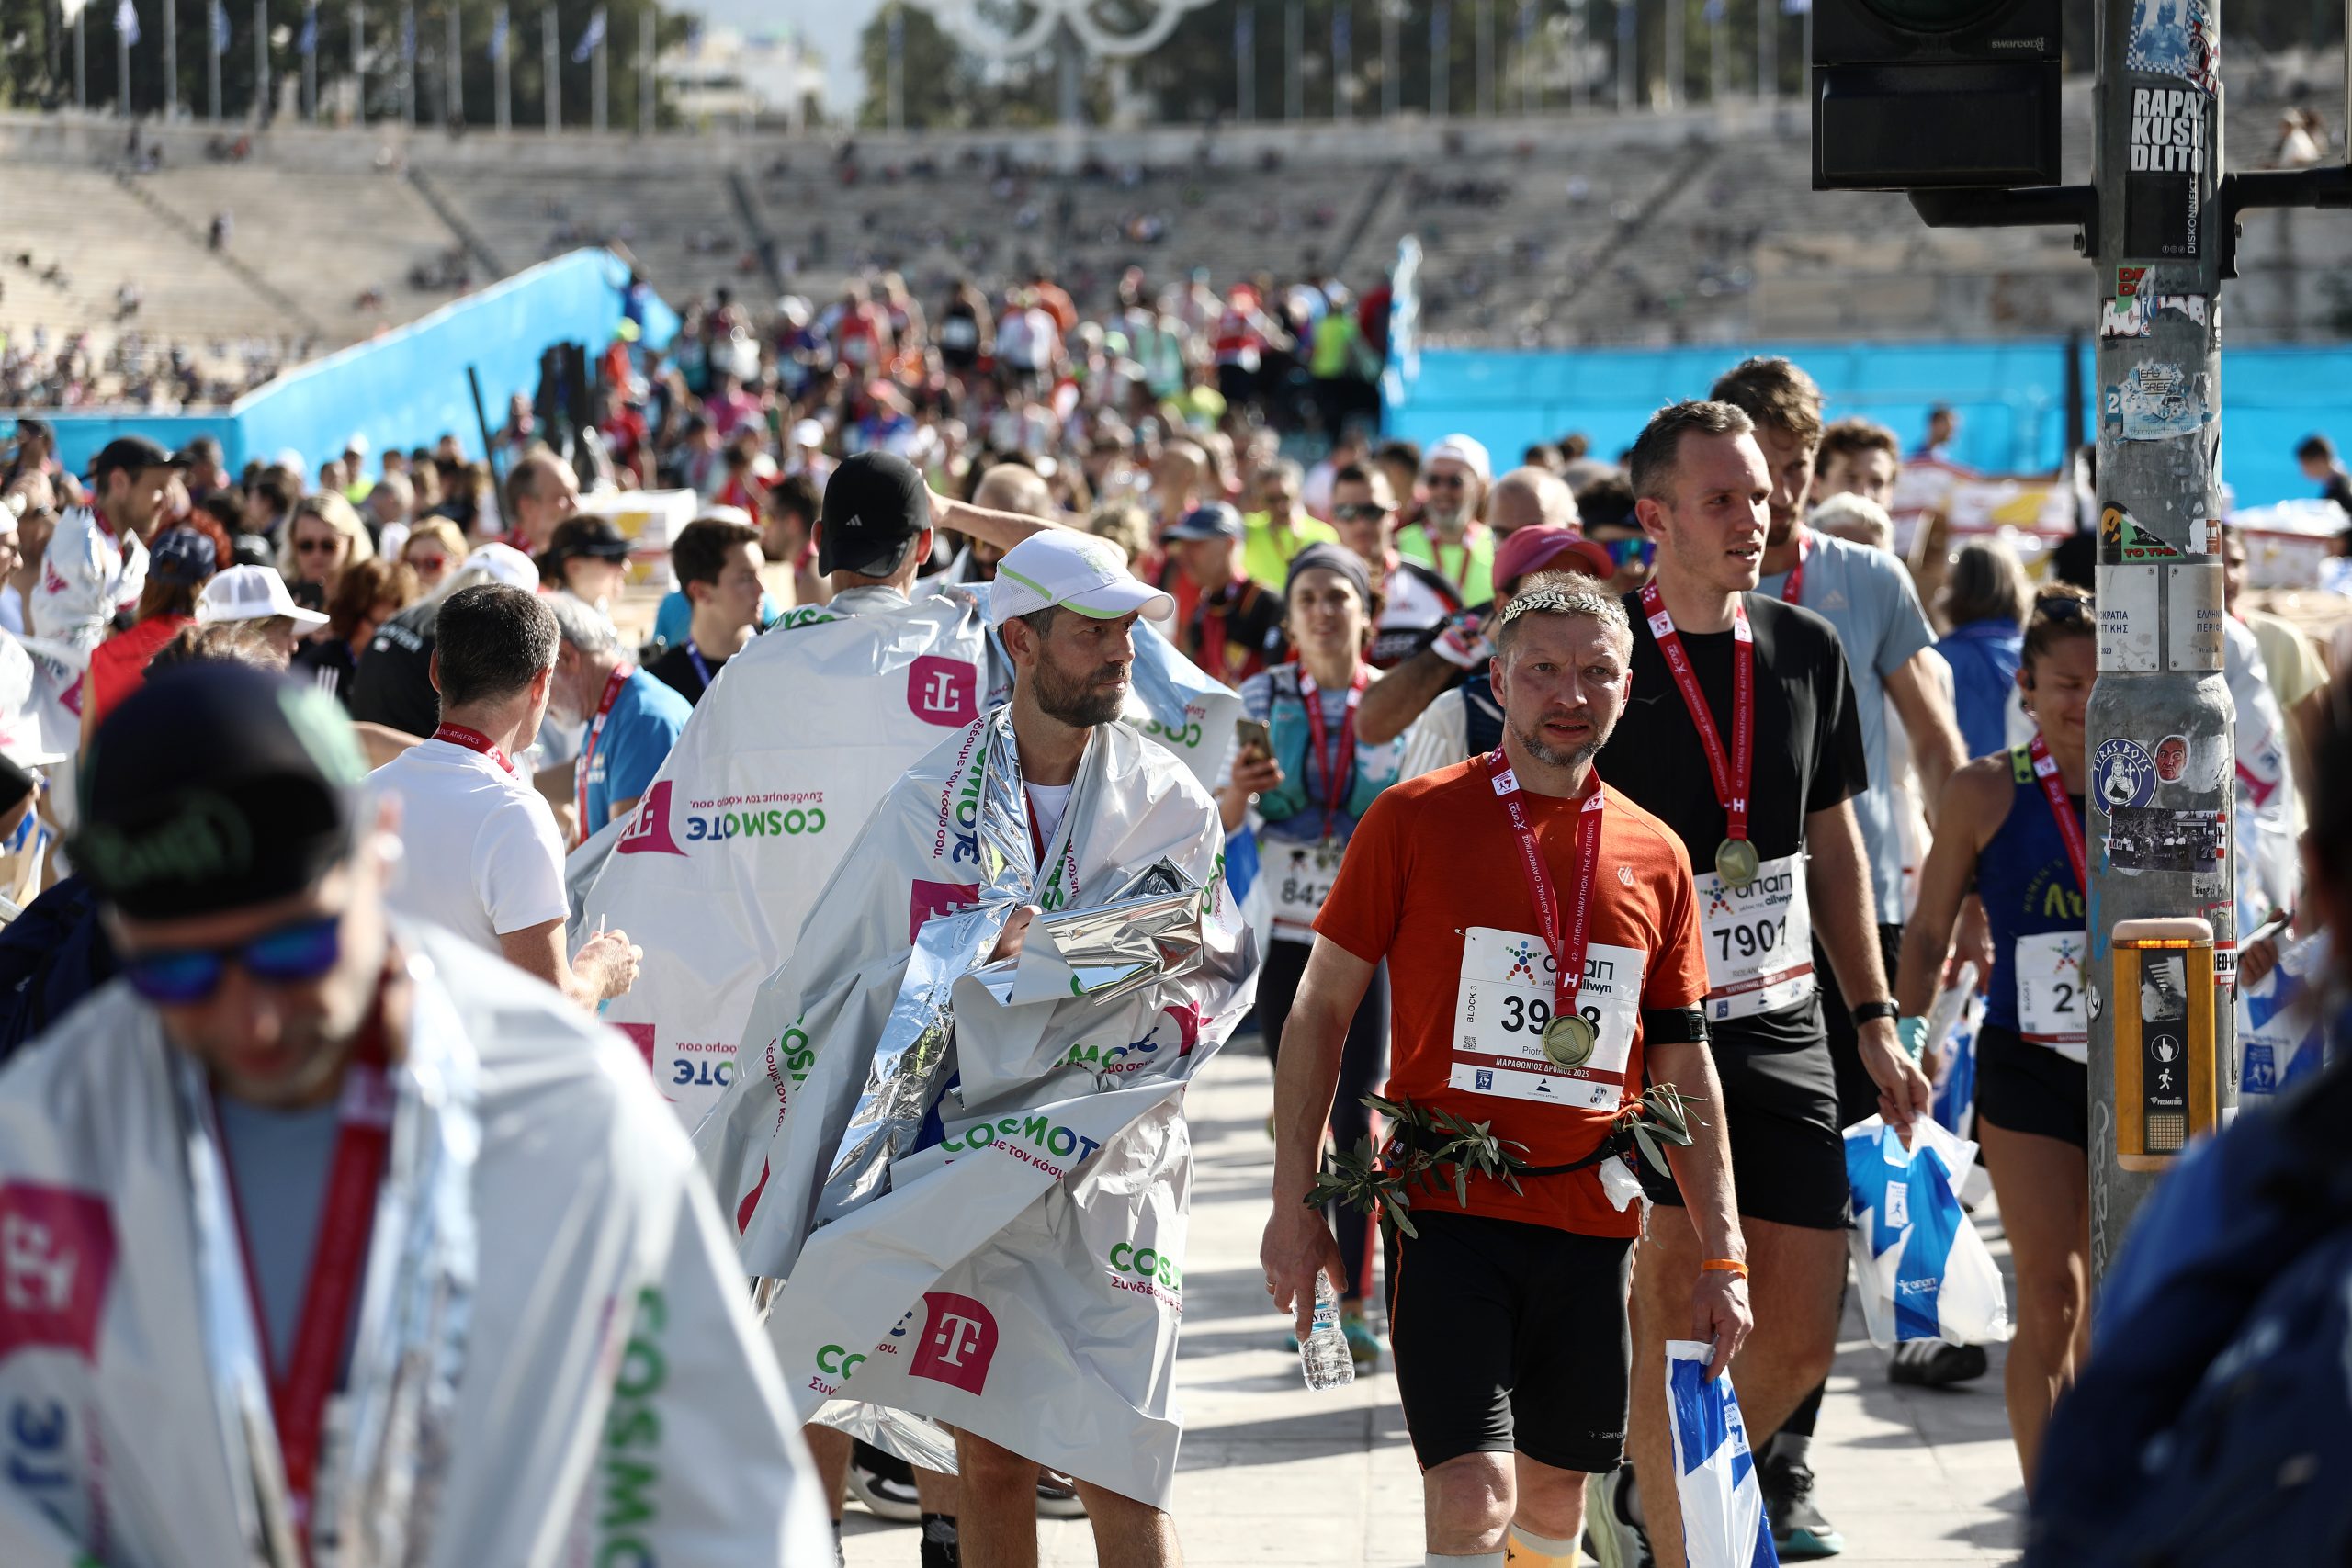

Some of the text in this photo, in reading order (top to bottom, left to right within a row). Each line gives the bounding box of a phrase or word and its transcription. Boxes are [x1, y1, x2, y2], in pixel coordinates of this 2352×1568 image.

[2187, 178, 2198, 254] DISKONNEKT
[449, 730, 480, 745] ATHLETICS
[2094, 740, 2153, 773] TYRAS BOYS
[745, 794, 762, 806] τον
[686, 807, 826, 840] COSMOTE
[1585, 819, 1595, 861] AUTHENTIC
[1583, 861, 1591, 874] THE
[1573, 919, 1583, 946] ATHENS
[1713, 915, 1786, 962] 7901
[1580, 978, 1612, 995] llwyn
[1466, 992, 1476, 1023] BLOCK
[1500, 995, 1601, 1041] 398
[1521, 1045, 1542, 1055] Piotr
[1496, 1057, 1543, 1072] ΜΑΡΑΘΩΝΙΟΣ
[1573, 1068, 1590, 1078] 2025
[940, 1115, 1101, 1165] COSMOT
[1007, 1144, 1032, 1163] τον
[1031, 1157, 1068, 1181] κόσμ
